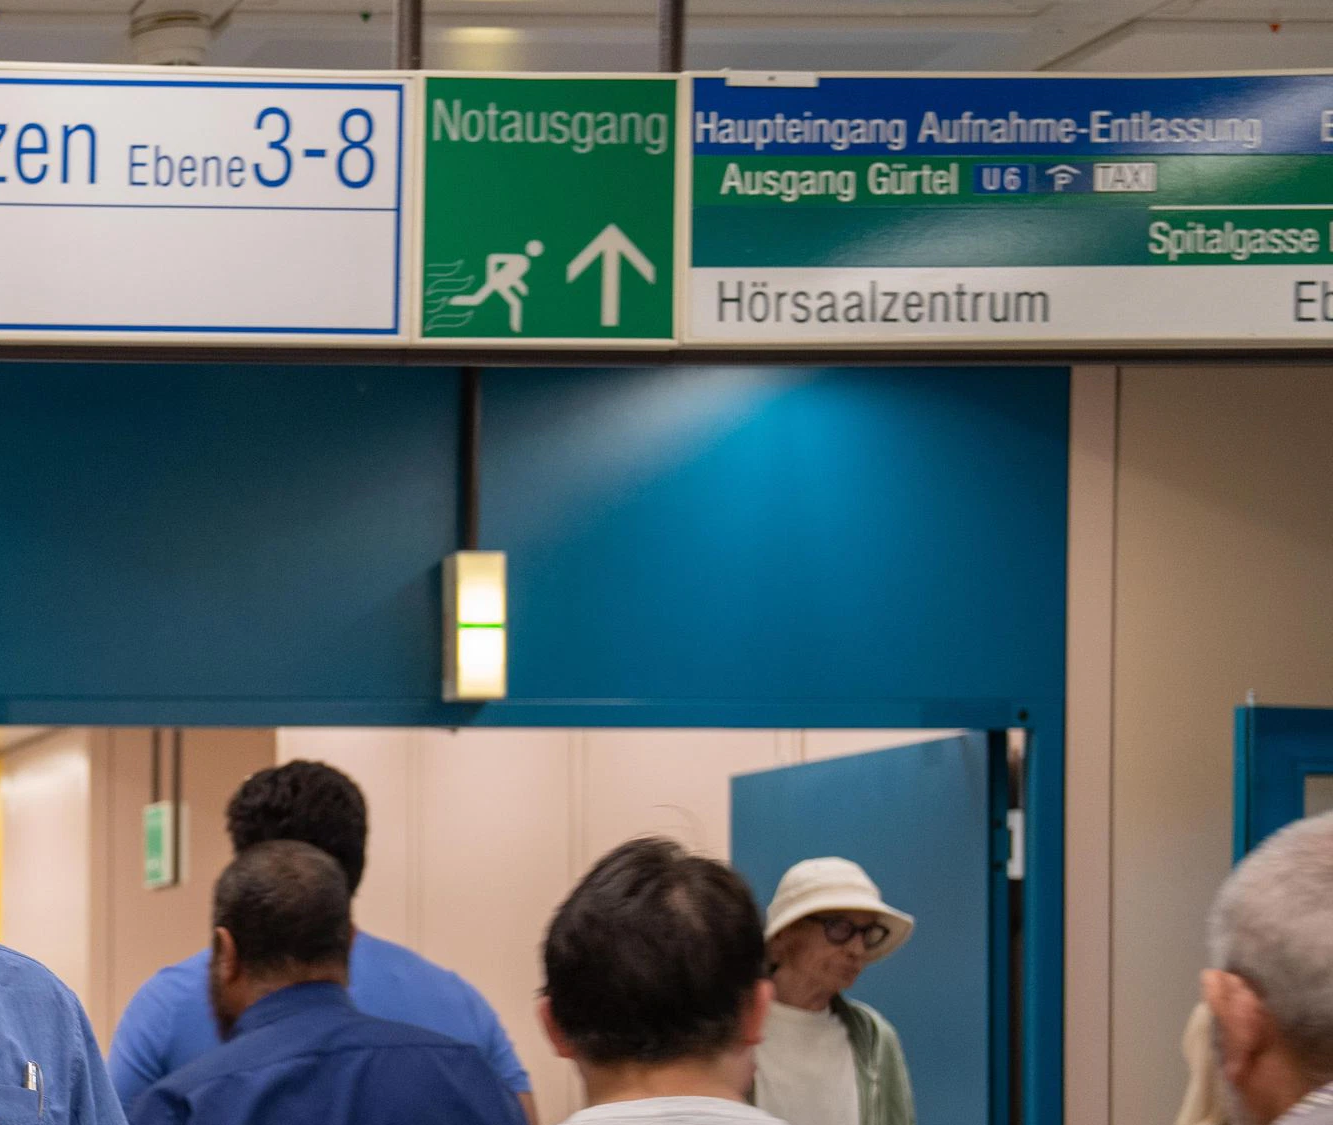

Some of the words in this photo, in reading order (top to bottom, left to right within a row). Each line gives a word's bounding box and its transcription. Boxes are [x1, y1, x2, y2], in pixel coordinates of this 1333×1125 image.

[433, 98, 668, 154] Notausgang
[694, 111, 907, 151] Haupteingang
[917, 110, 1261, 150] Aufnahme-Entlassung
[130, 145, 246, 187] Ebene
[254, 106, 376, 190] 3-8
[720, 162, 856, 202] Ausgang
[867, 162, 959, 194] Gürtel
[981, 167, 1022, 191] U6
[1095, 164, 1155, 190] TAXI
[1148, 221, 1320, 261] Spitalgasse
[717, 280, 1051, 323] Hörsaalzentrum
